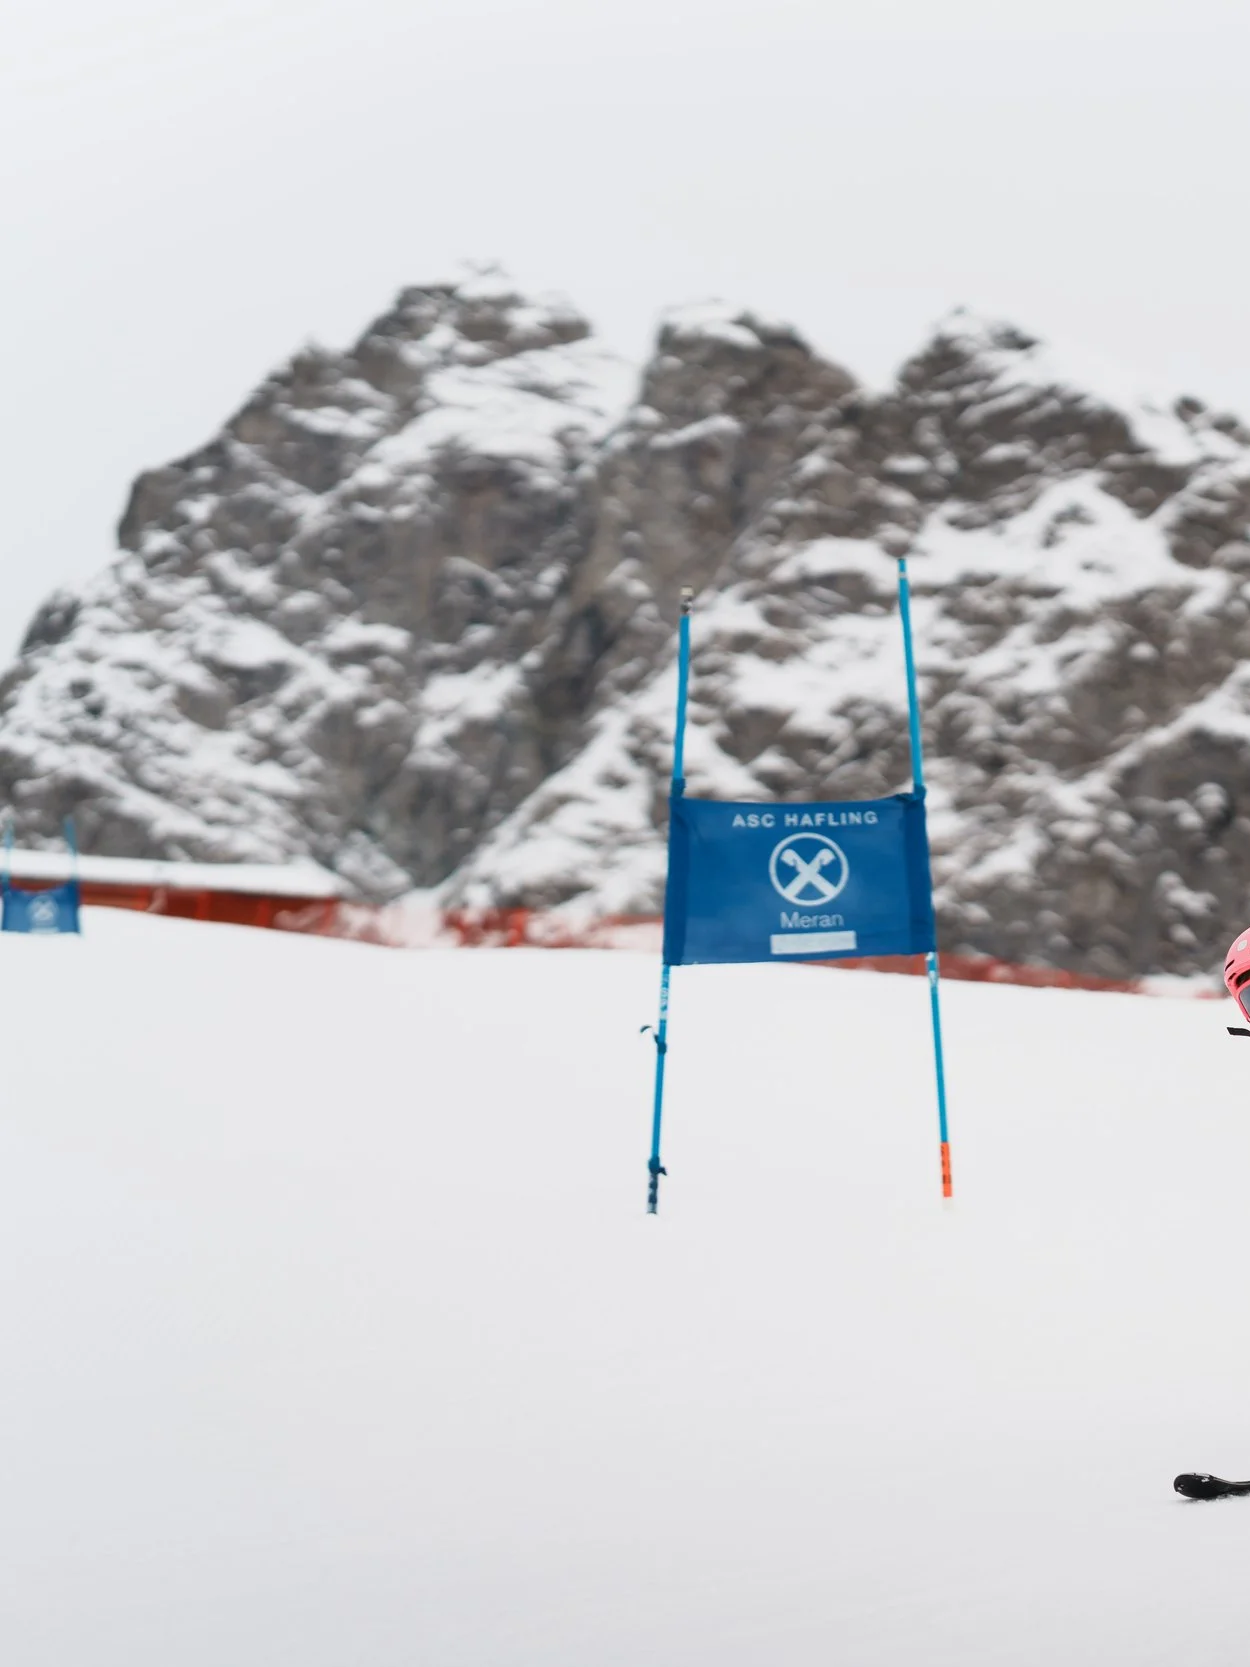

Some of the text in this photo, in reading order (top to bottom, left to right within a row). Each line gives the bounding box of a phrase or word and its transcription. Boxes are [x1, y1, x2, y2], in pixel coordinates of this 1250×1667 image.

[732, 811, 878, 828] ASC HAFLING
[780, 911, 844, 929] Meran
